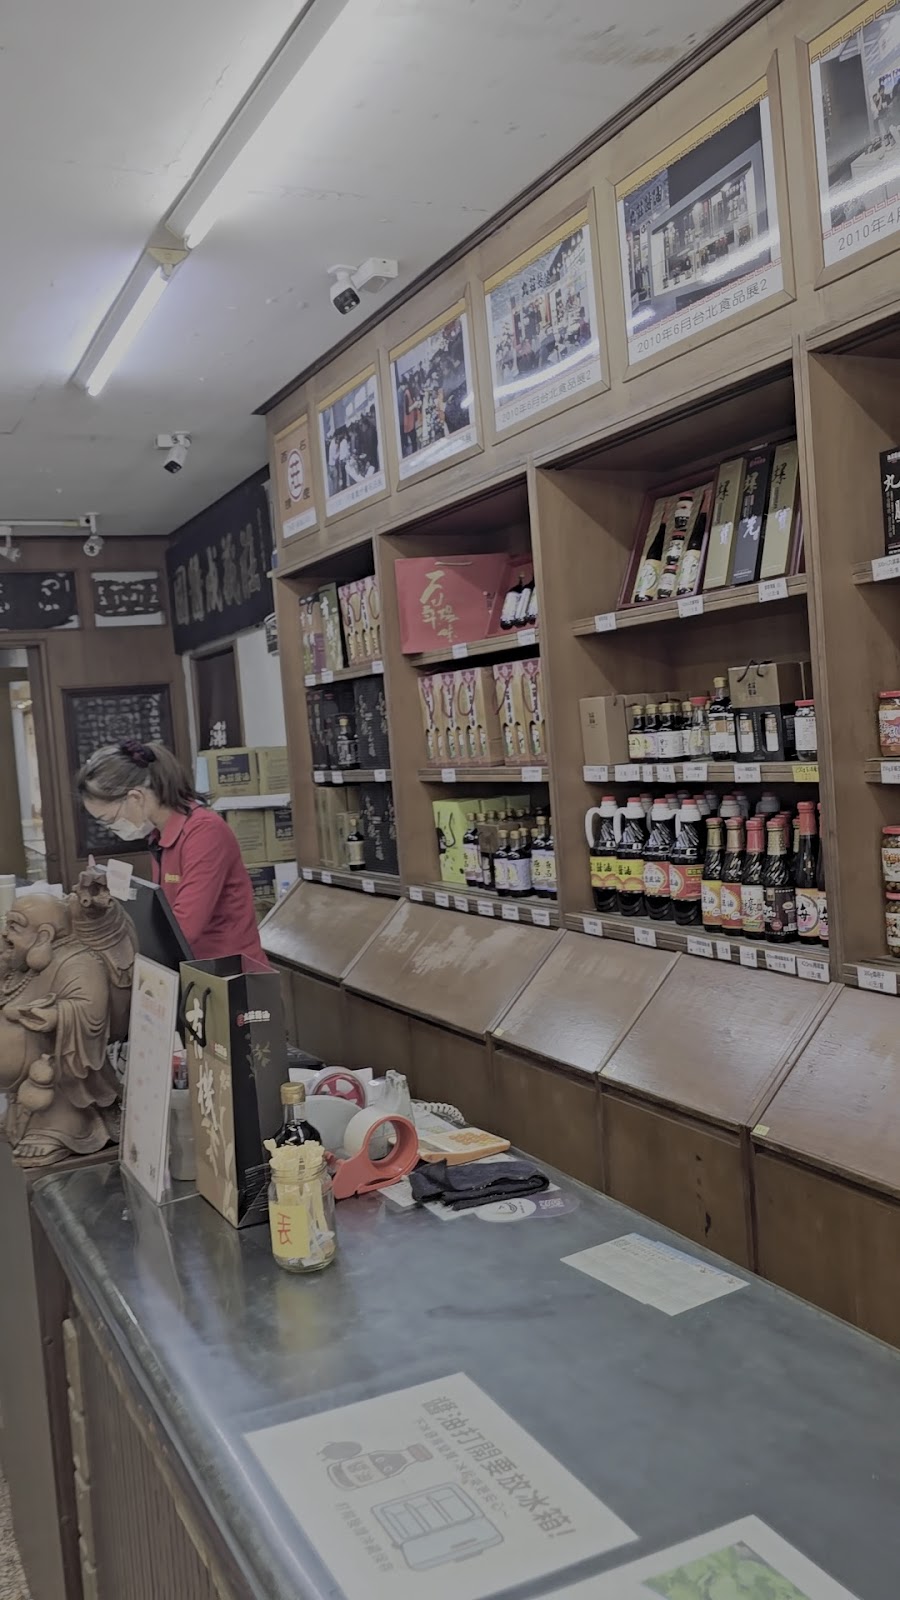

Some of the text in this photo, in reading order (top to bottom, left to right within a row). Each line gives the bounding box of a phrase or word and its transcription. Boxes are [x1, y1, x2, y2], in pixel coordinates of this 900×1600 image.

[838, 207, 900, 251] 2010年4
[637, 278, 768, 354] 2010年6月台北食品展2
[501, 369, 592, 424] 2010年6月台北食品展2
